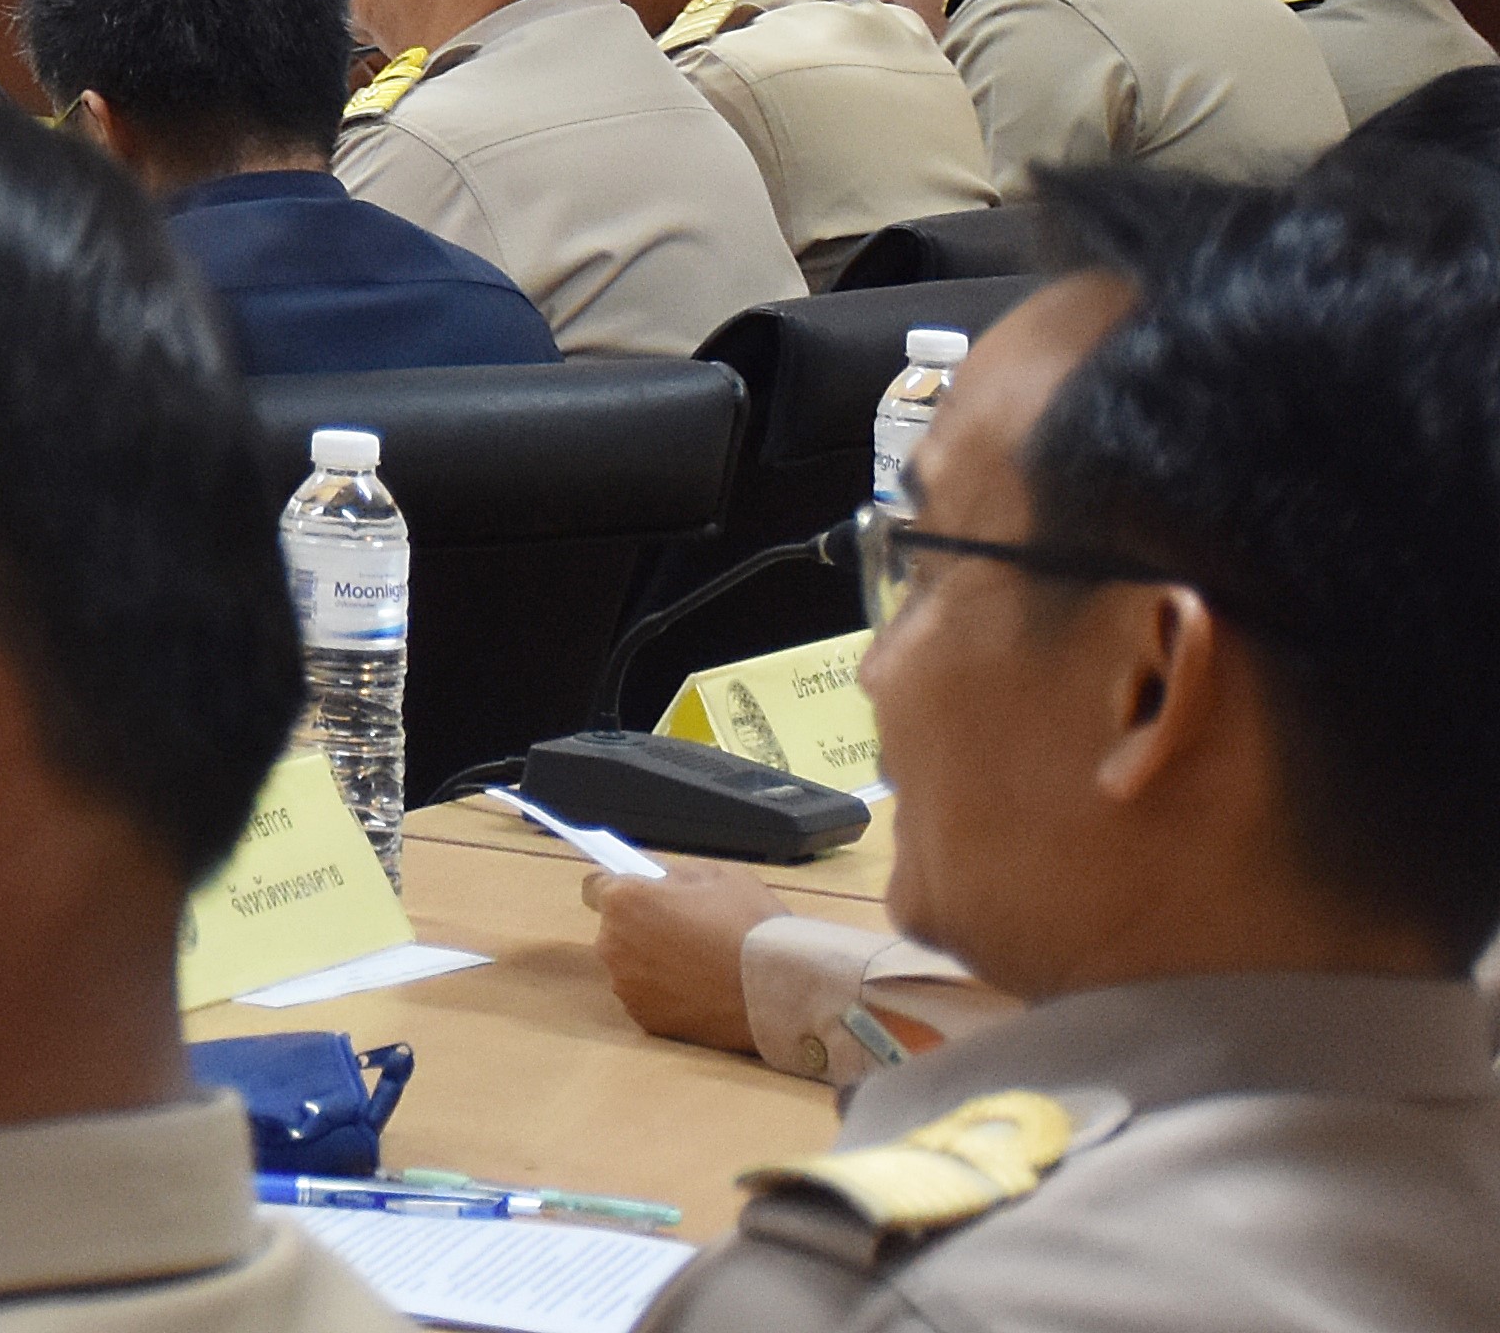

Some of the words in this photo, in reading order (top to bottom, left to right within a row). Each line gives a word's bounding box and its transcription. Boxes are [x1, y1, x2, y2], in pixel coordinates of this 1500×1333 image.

[227, 863, 345, 918] จังหวัดหนองคาย
